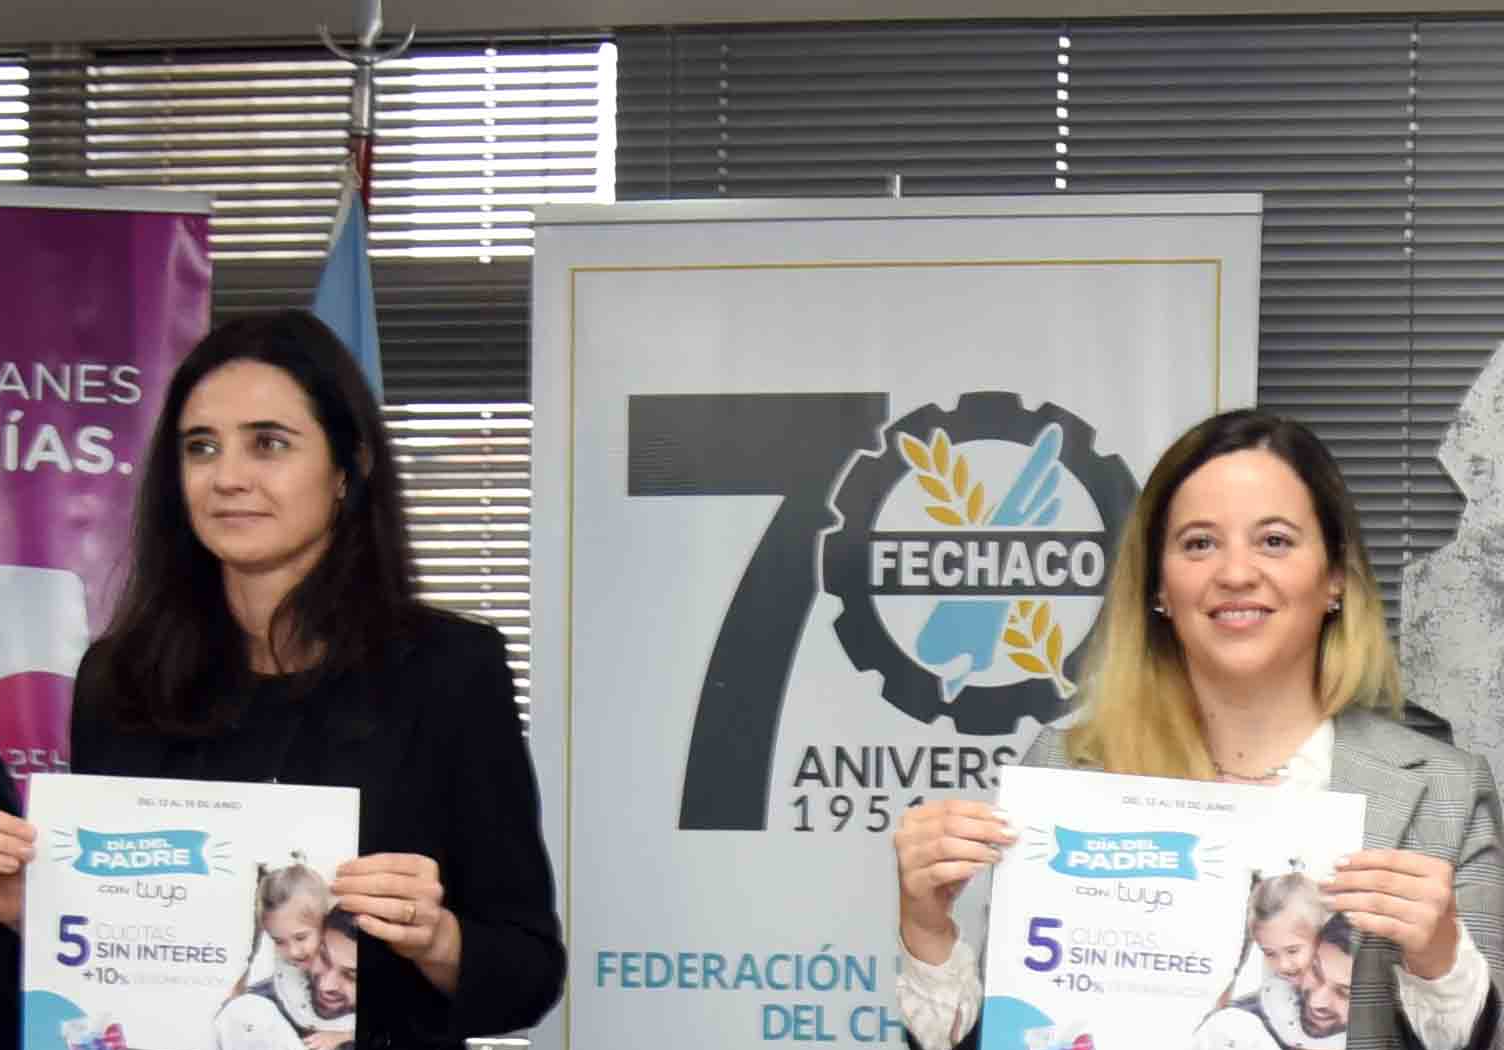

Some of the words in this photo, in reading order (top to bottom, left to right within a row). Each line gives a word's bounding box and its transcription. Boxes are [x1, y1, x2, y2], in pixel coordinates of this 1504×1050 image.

[869, 537, 1105, 587] FECHACO
[792, 794, 923, 833] 195
[90, 844, 190, 872] PADRE
[137, 837, 172, 851] DEL
[1068, 842, 1179, 876] PADRE
[1086, 836, 1120, 853] DÍA
[1121, 837, 1159, 853] DEL
[55, 915, 90, 967] 5
[97, 941, 131, 959] SIN
[137, 937, 227, 964] INTERÉS
[1023, 916, 1065, 973] 5
[1070, 946, 1107, 966] SIN
[1113, 943, 1213, 975] INTERÉS
[596, 943, 878, 993] FEDERACIÓN
[760, 1004, 838, 1043] DEL
